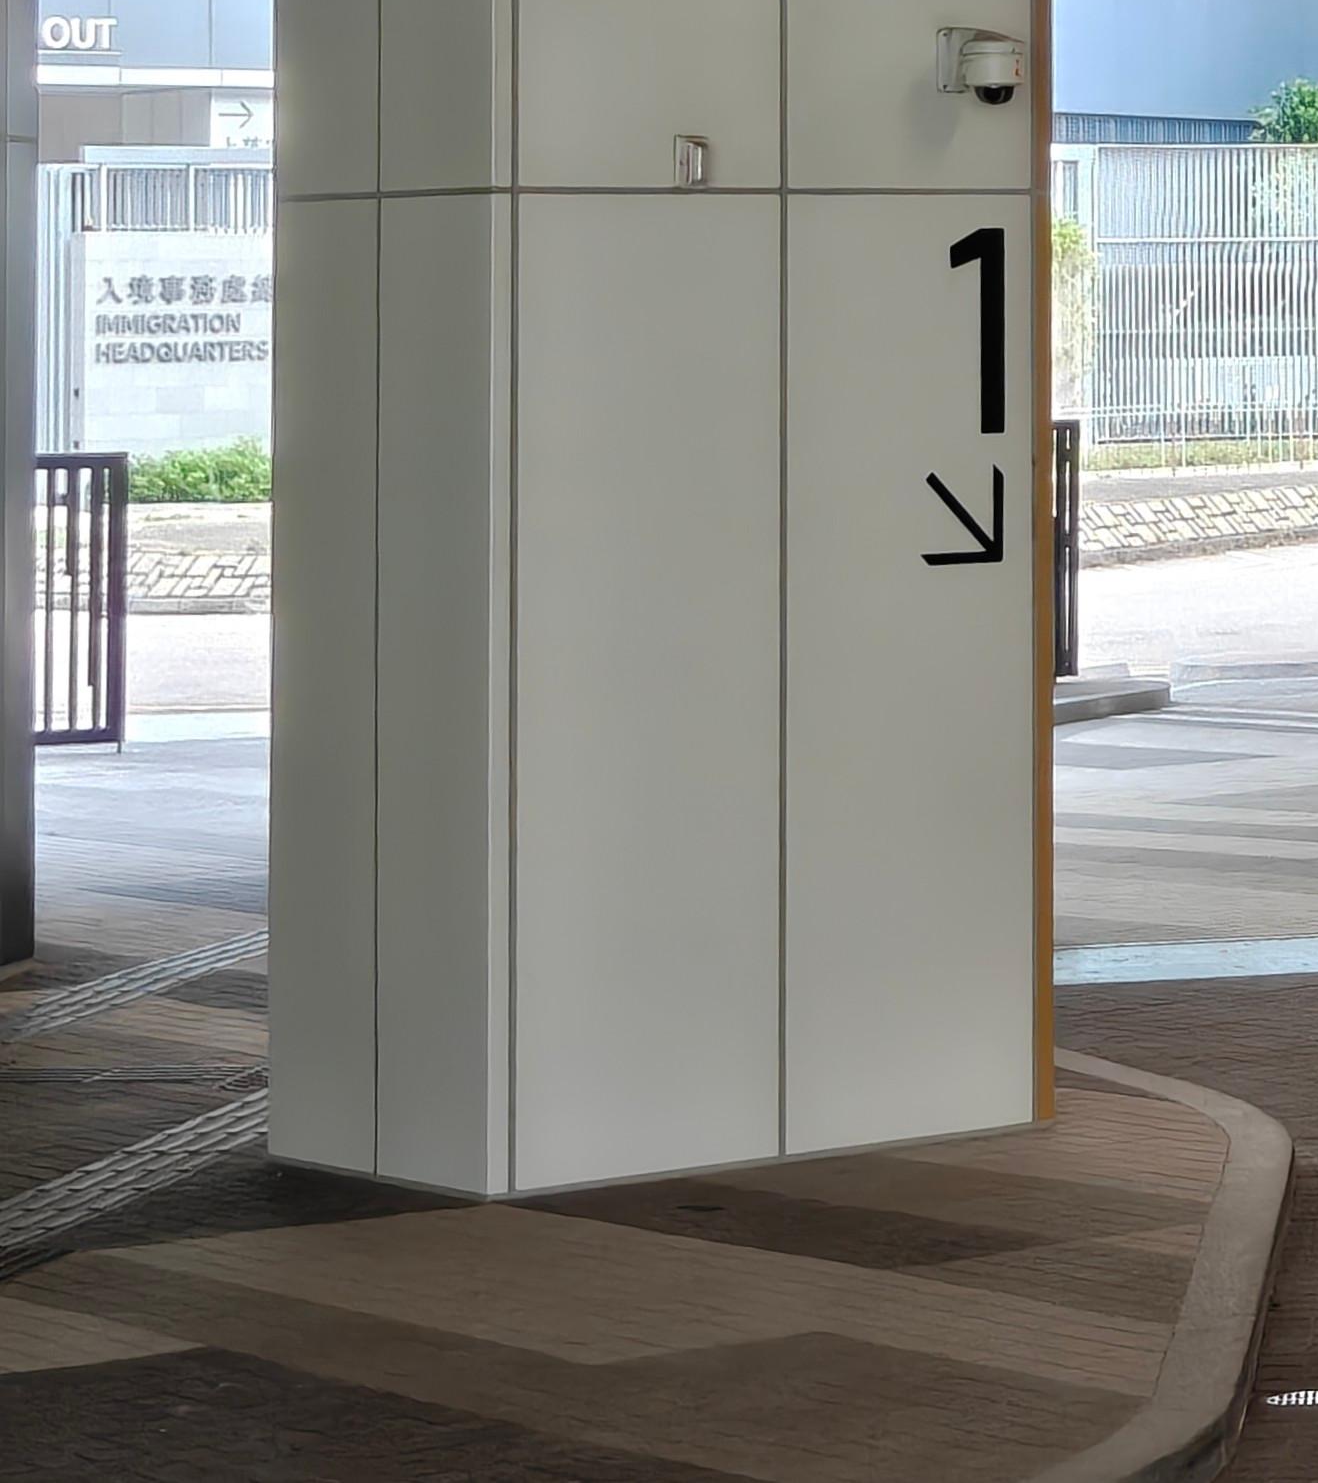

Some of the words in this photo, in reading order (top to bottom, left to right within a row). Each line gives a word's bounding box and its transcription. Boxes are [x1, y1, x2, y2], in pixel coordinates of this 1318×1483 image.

[41, 16, 118, 50] OUT
[95, 313, 241, 335] IMMIGRATION
[950, 228, 1005, 434] 1
[95, 341, 269, 364] HEADQUARTERS
